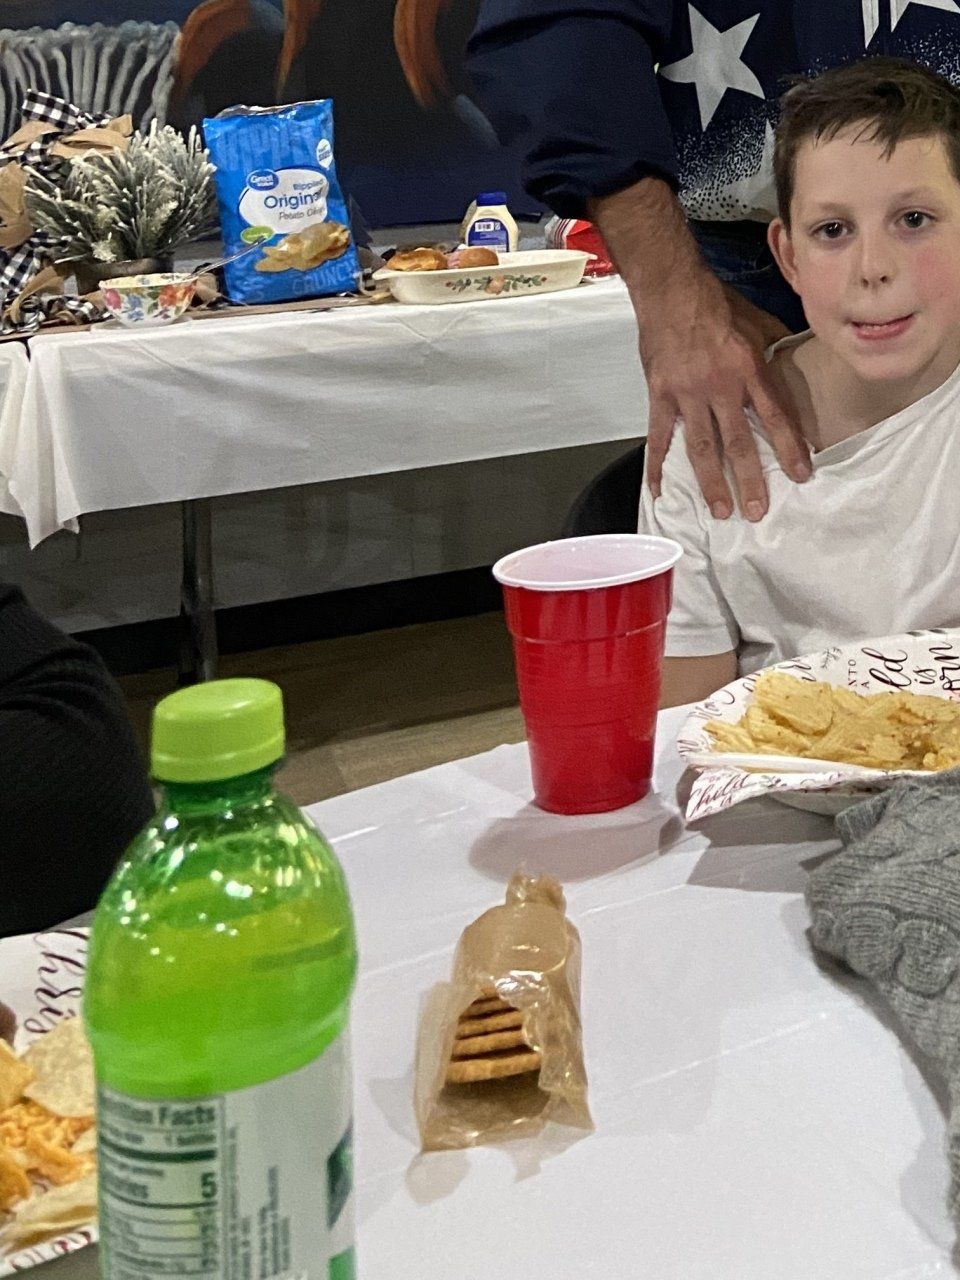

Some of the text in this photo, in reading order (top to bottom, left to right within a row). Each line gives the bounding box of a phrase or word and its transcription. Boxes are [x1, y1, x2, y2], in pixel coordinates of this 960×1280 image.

[264, 187, 324, 209] Original
[279, 211, 304, 220] Potato
[202, 1172, 217, 1199] 5
